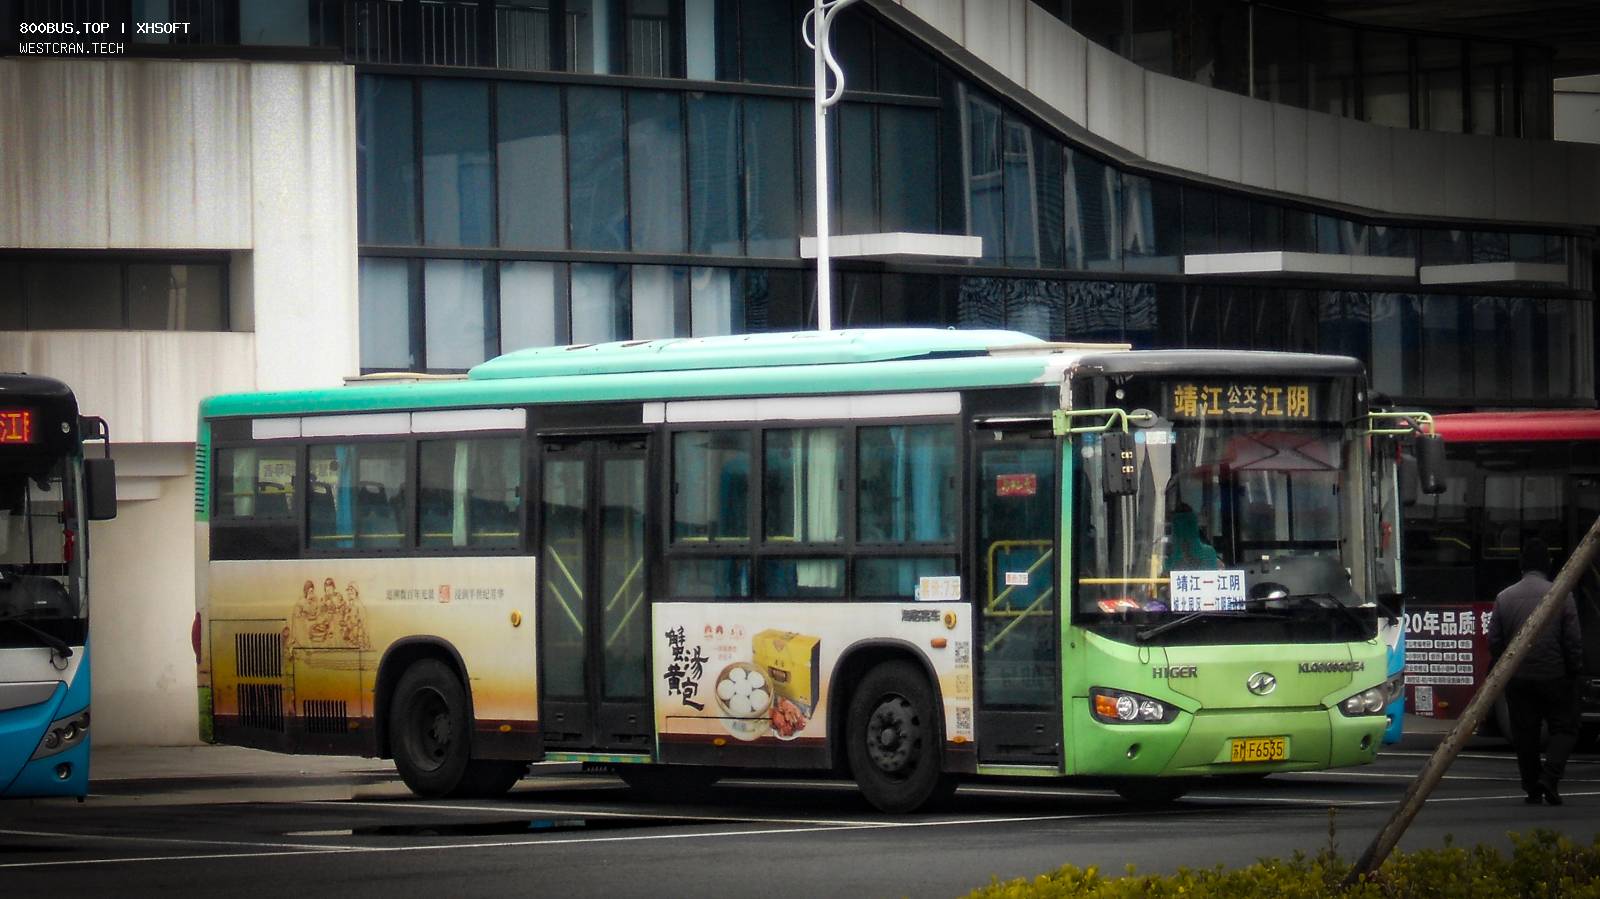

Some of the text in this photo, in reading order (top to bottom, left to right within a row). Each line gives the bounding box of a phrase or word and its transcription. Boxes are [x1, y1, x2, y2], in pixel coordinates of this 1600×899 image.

[1174, 384, 1310, 417] 靖江 公交 江阴
[1152, 666, 1198, 679] HIGER
